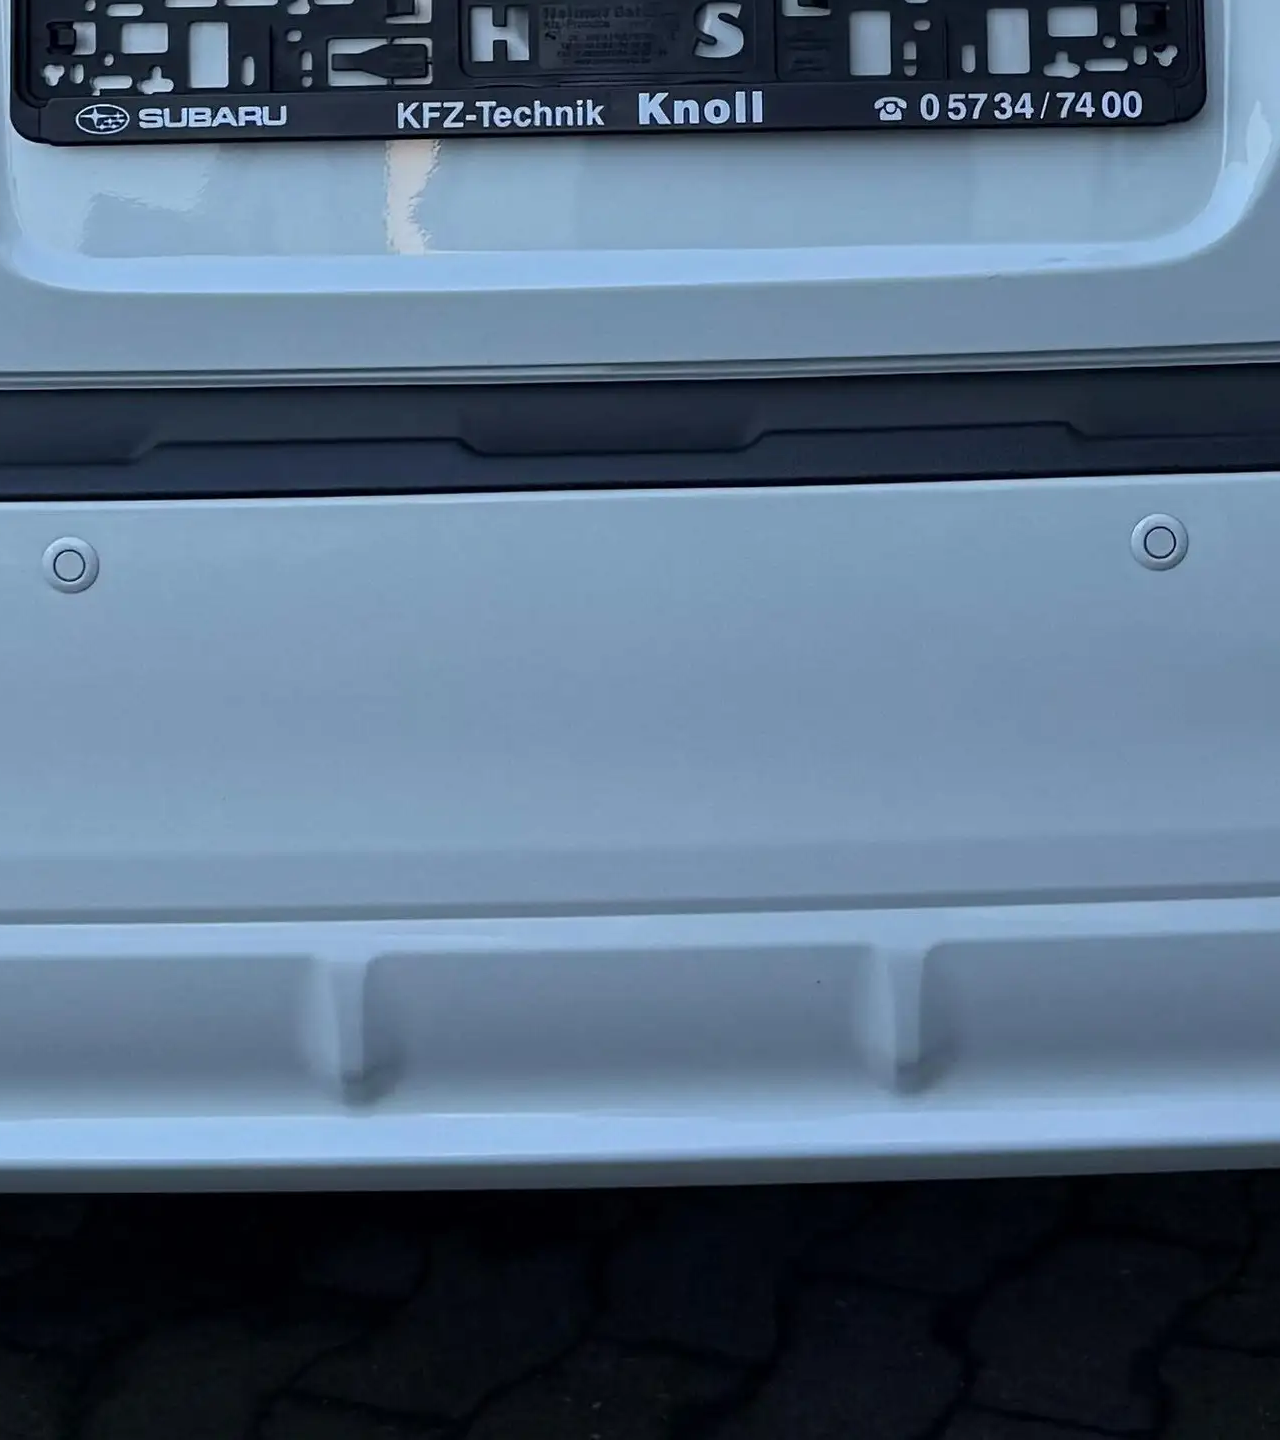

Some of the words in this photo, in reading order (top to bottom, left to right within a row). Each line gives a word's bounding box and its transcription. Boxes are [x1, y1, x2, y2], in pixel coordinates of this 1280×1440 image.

[138, 105, 288, 129] SUBARU
[397, 99, 605, 129] KFZ-Technik
[638, 90, 764, 125] Knoll
